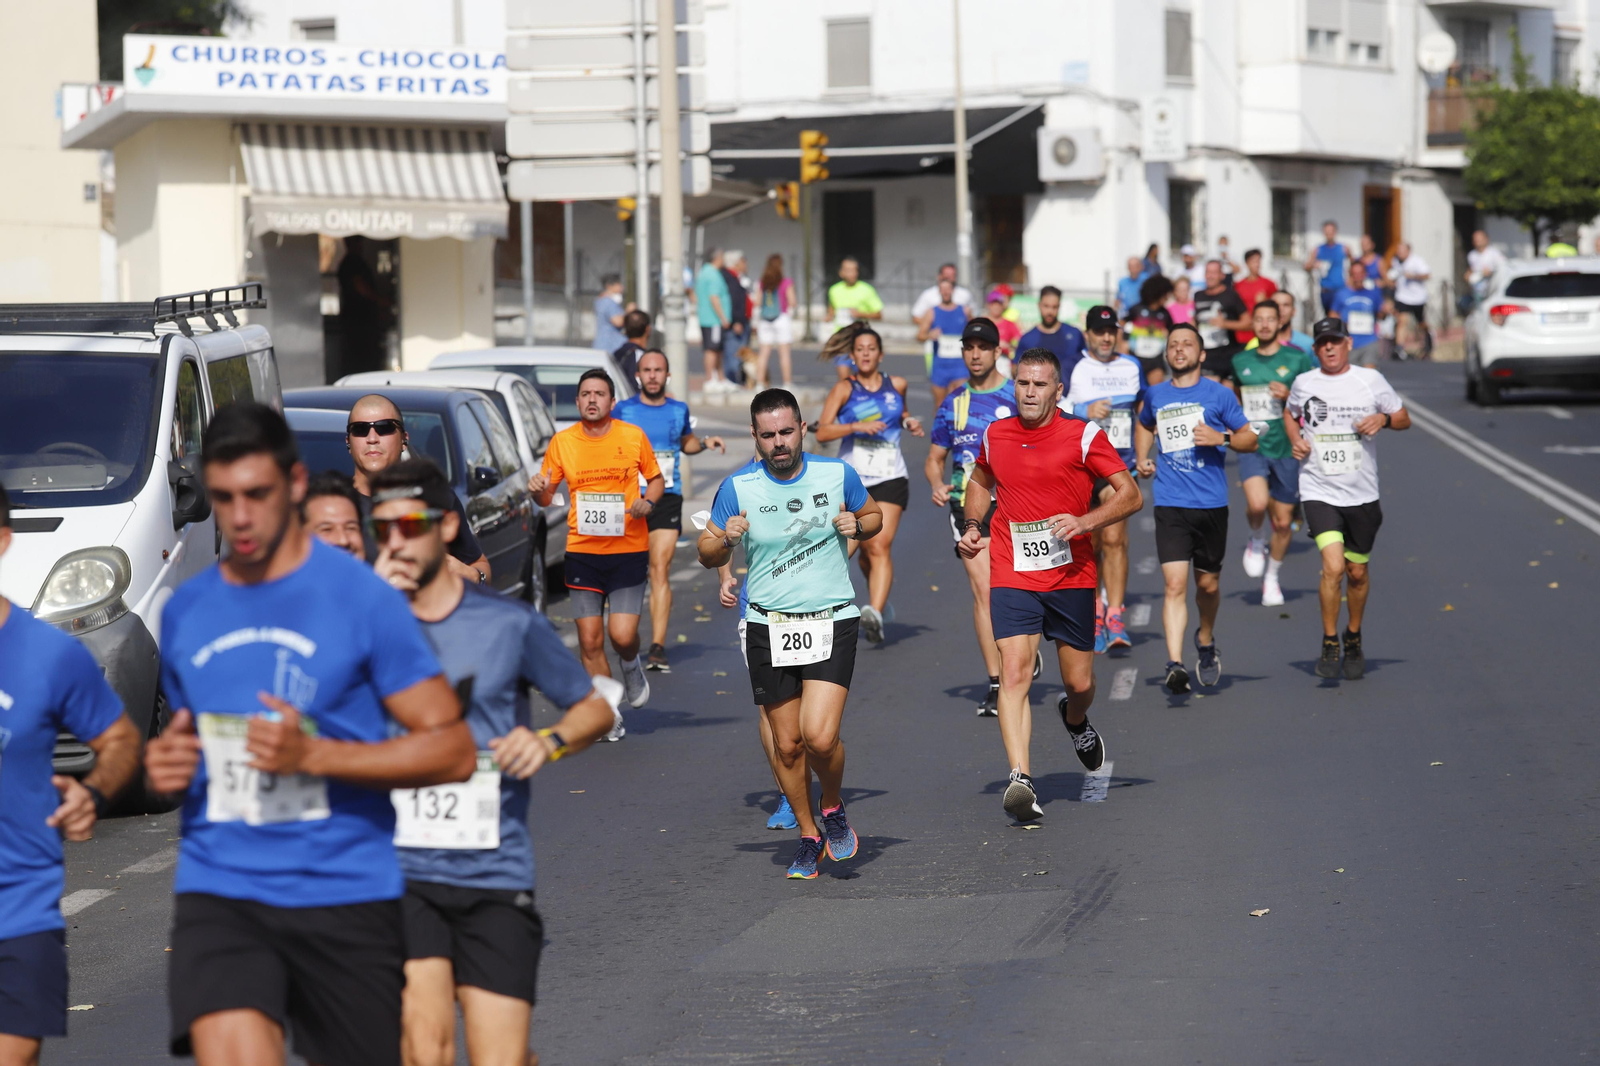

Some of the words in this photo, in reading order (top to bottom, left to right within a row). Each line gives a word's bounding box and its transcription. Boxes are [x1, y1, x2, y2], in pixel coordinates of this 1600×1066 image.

[171, 44, 327, 66] CHURROS
[217, 71, 366, 92] PATATAS
[377, 76, 490, 96] FRITAS
[324, 207, 414, 232] ONUTAPI
[1166, 423, 1189, 441] 558
[867, 454, 874, 466] 7
[1323, 450, 1346, 463] 493
[584, 509, 607, 525] 238
[1022, 539, 1050, 557] 539
[781, 631, 813, 651] 280
[410, 787, 459, 820] 132
